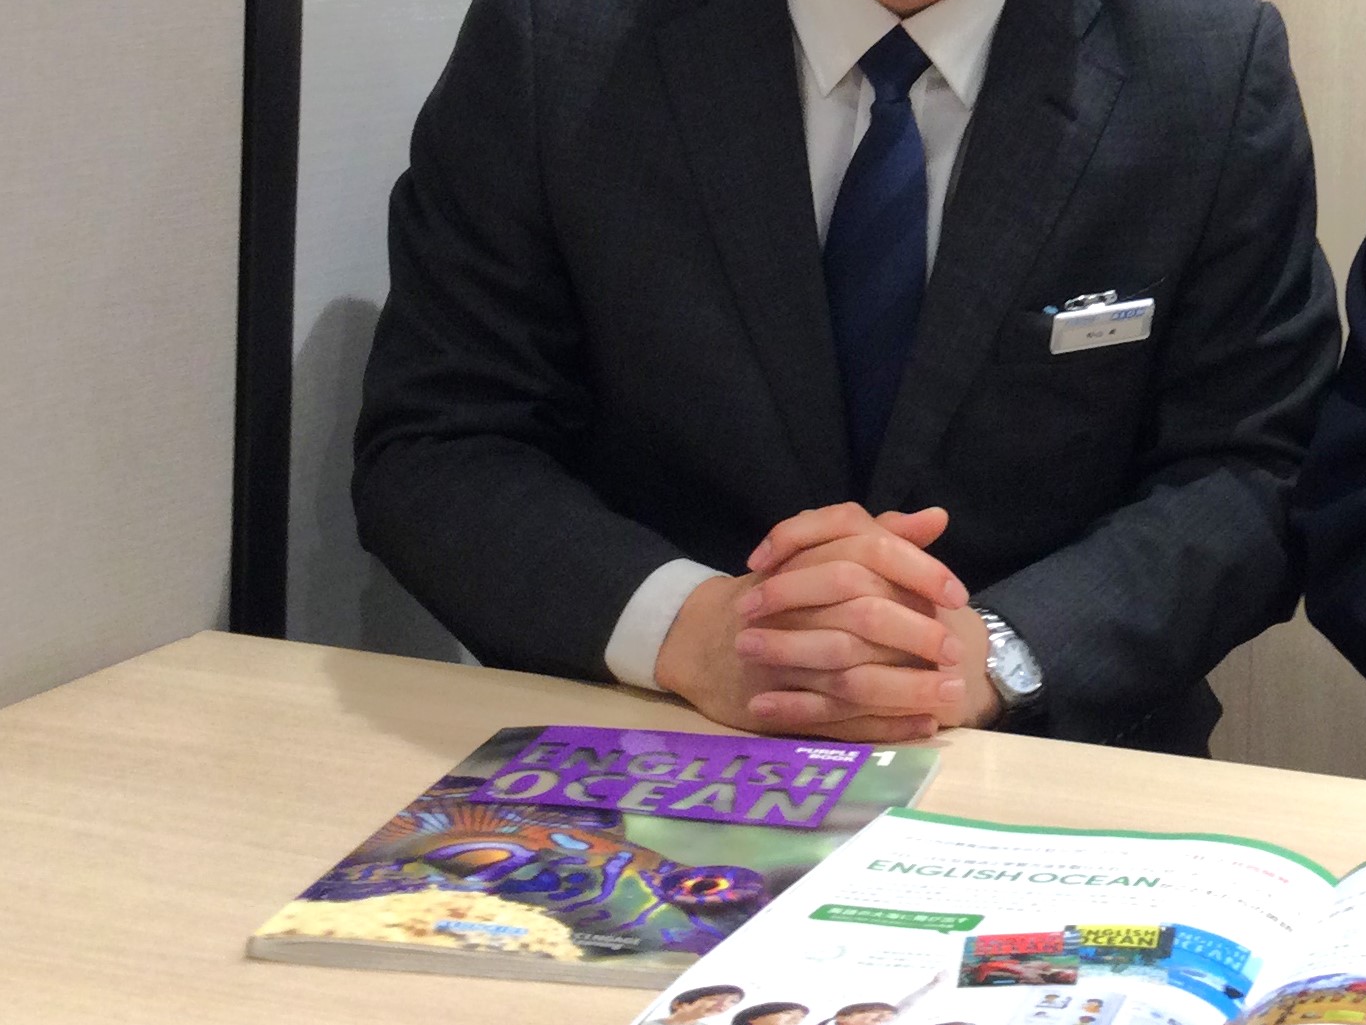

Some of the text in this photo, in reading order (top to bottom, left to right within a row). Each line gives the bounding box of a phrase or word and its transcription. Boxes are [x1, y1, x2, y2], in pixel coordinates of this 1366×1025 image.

[518, 739, 850, 793] ENGLISH
[871, 749, 897, 767] 1
[491, 766, 828, 825] OCEAN
[865, 859, 1024, 882] ENGLISH
[1027, 872, 1161, 888] OCEAN
